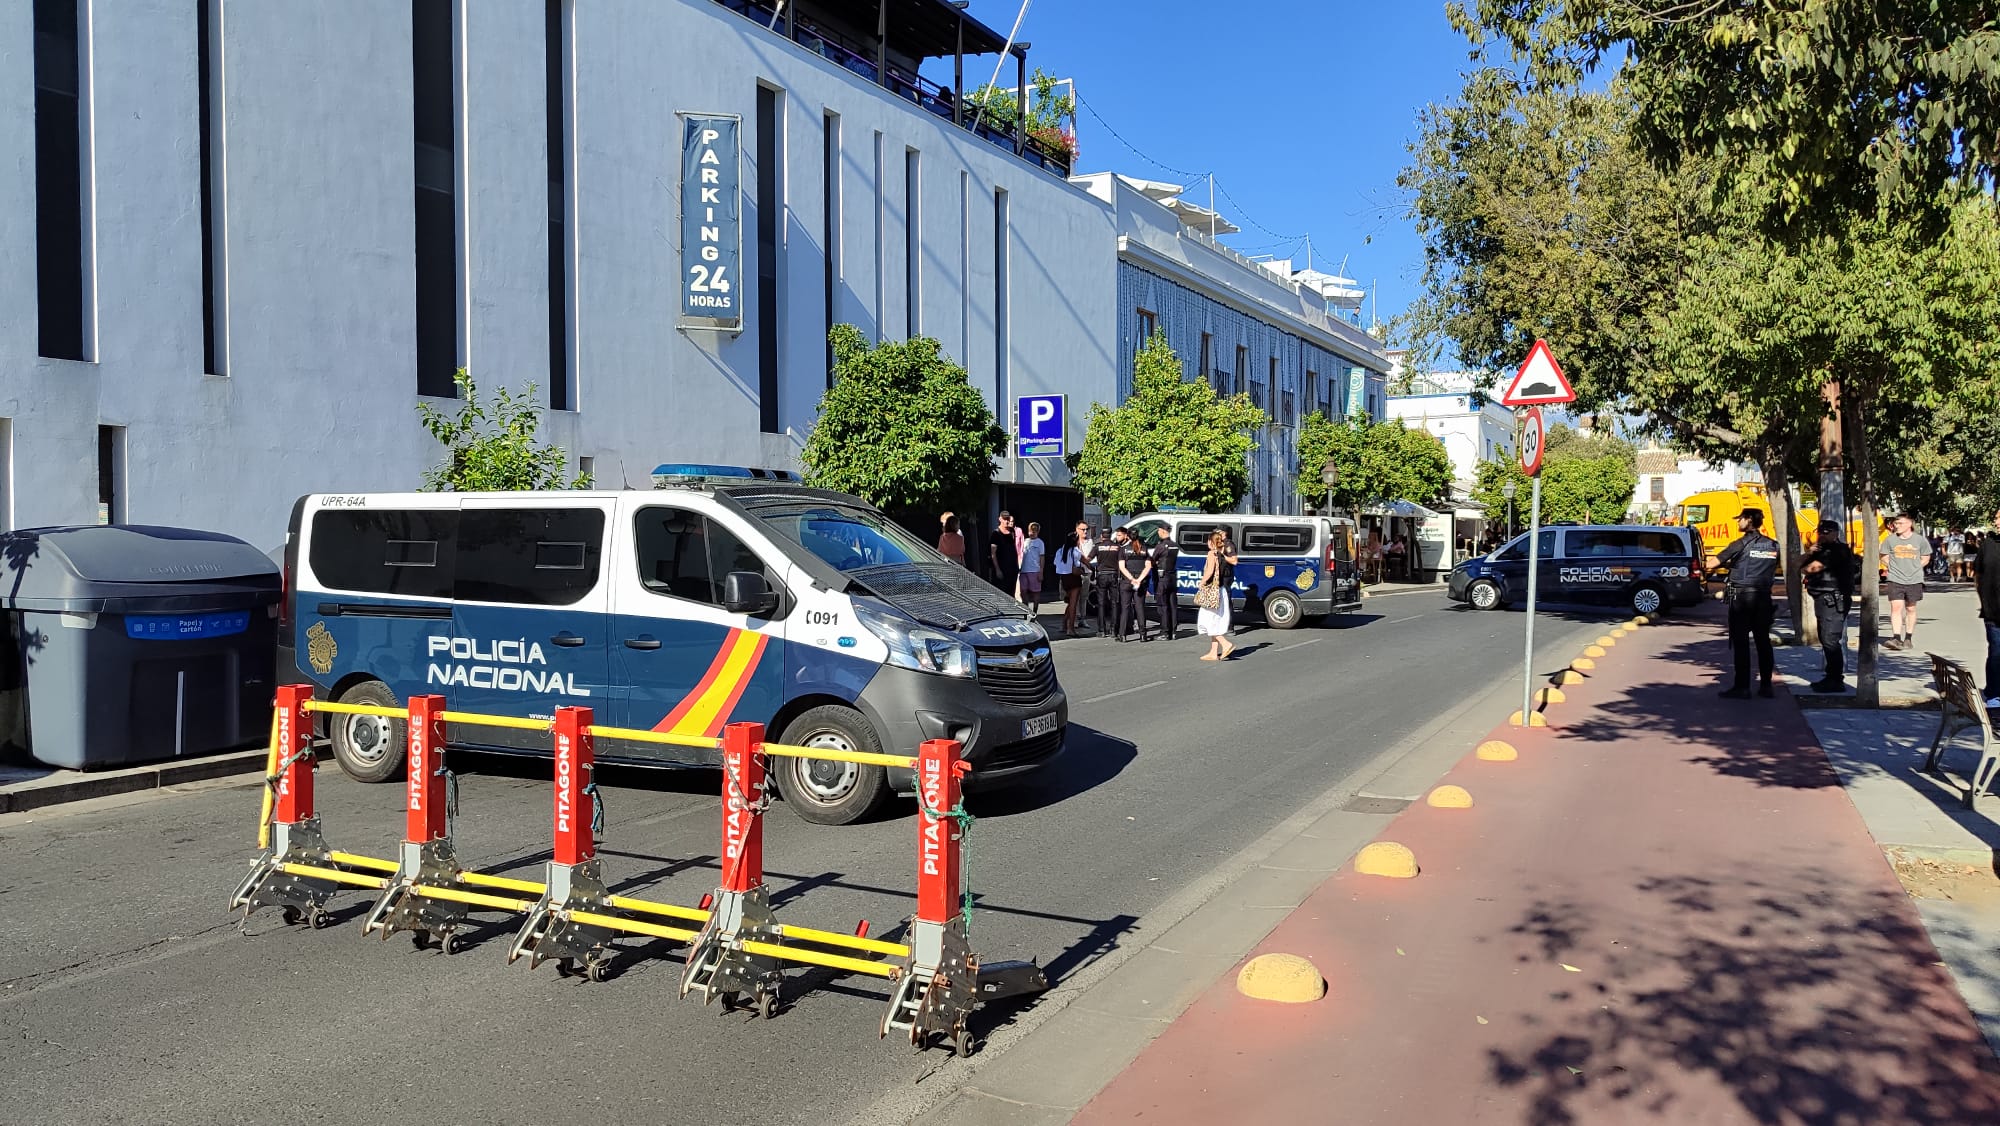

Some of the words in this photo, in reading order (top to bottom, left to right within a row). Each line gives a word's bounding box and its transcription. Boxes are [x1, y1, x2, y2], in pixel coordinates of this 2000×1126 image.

[700, 129, 720, 261] PARKING
[690, 264, 730, 293] 24
[689, 295, 731, 308] HORAS
[1031, 400, 1055, 434] P
[1525, 430, 1537, 454] 30
[321, 496, 366, 507] UPR-64A
[1560, 575, 1632, 583] NACIONAL
[179, 619, 198, 627] Papel
[813, 611, 838, 625] 091
[427, 636, 548, 666] POLICÍA
[427, 664, 592, 696] NACIONAL
[279, 707, 289, 795] PITAGONE
[410, 715, 423, 811] PITAGONE
[558, 735, 570, 833] PITAGONE
[727, 752, 741, 858] PITAGONE
